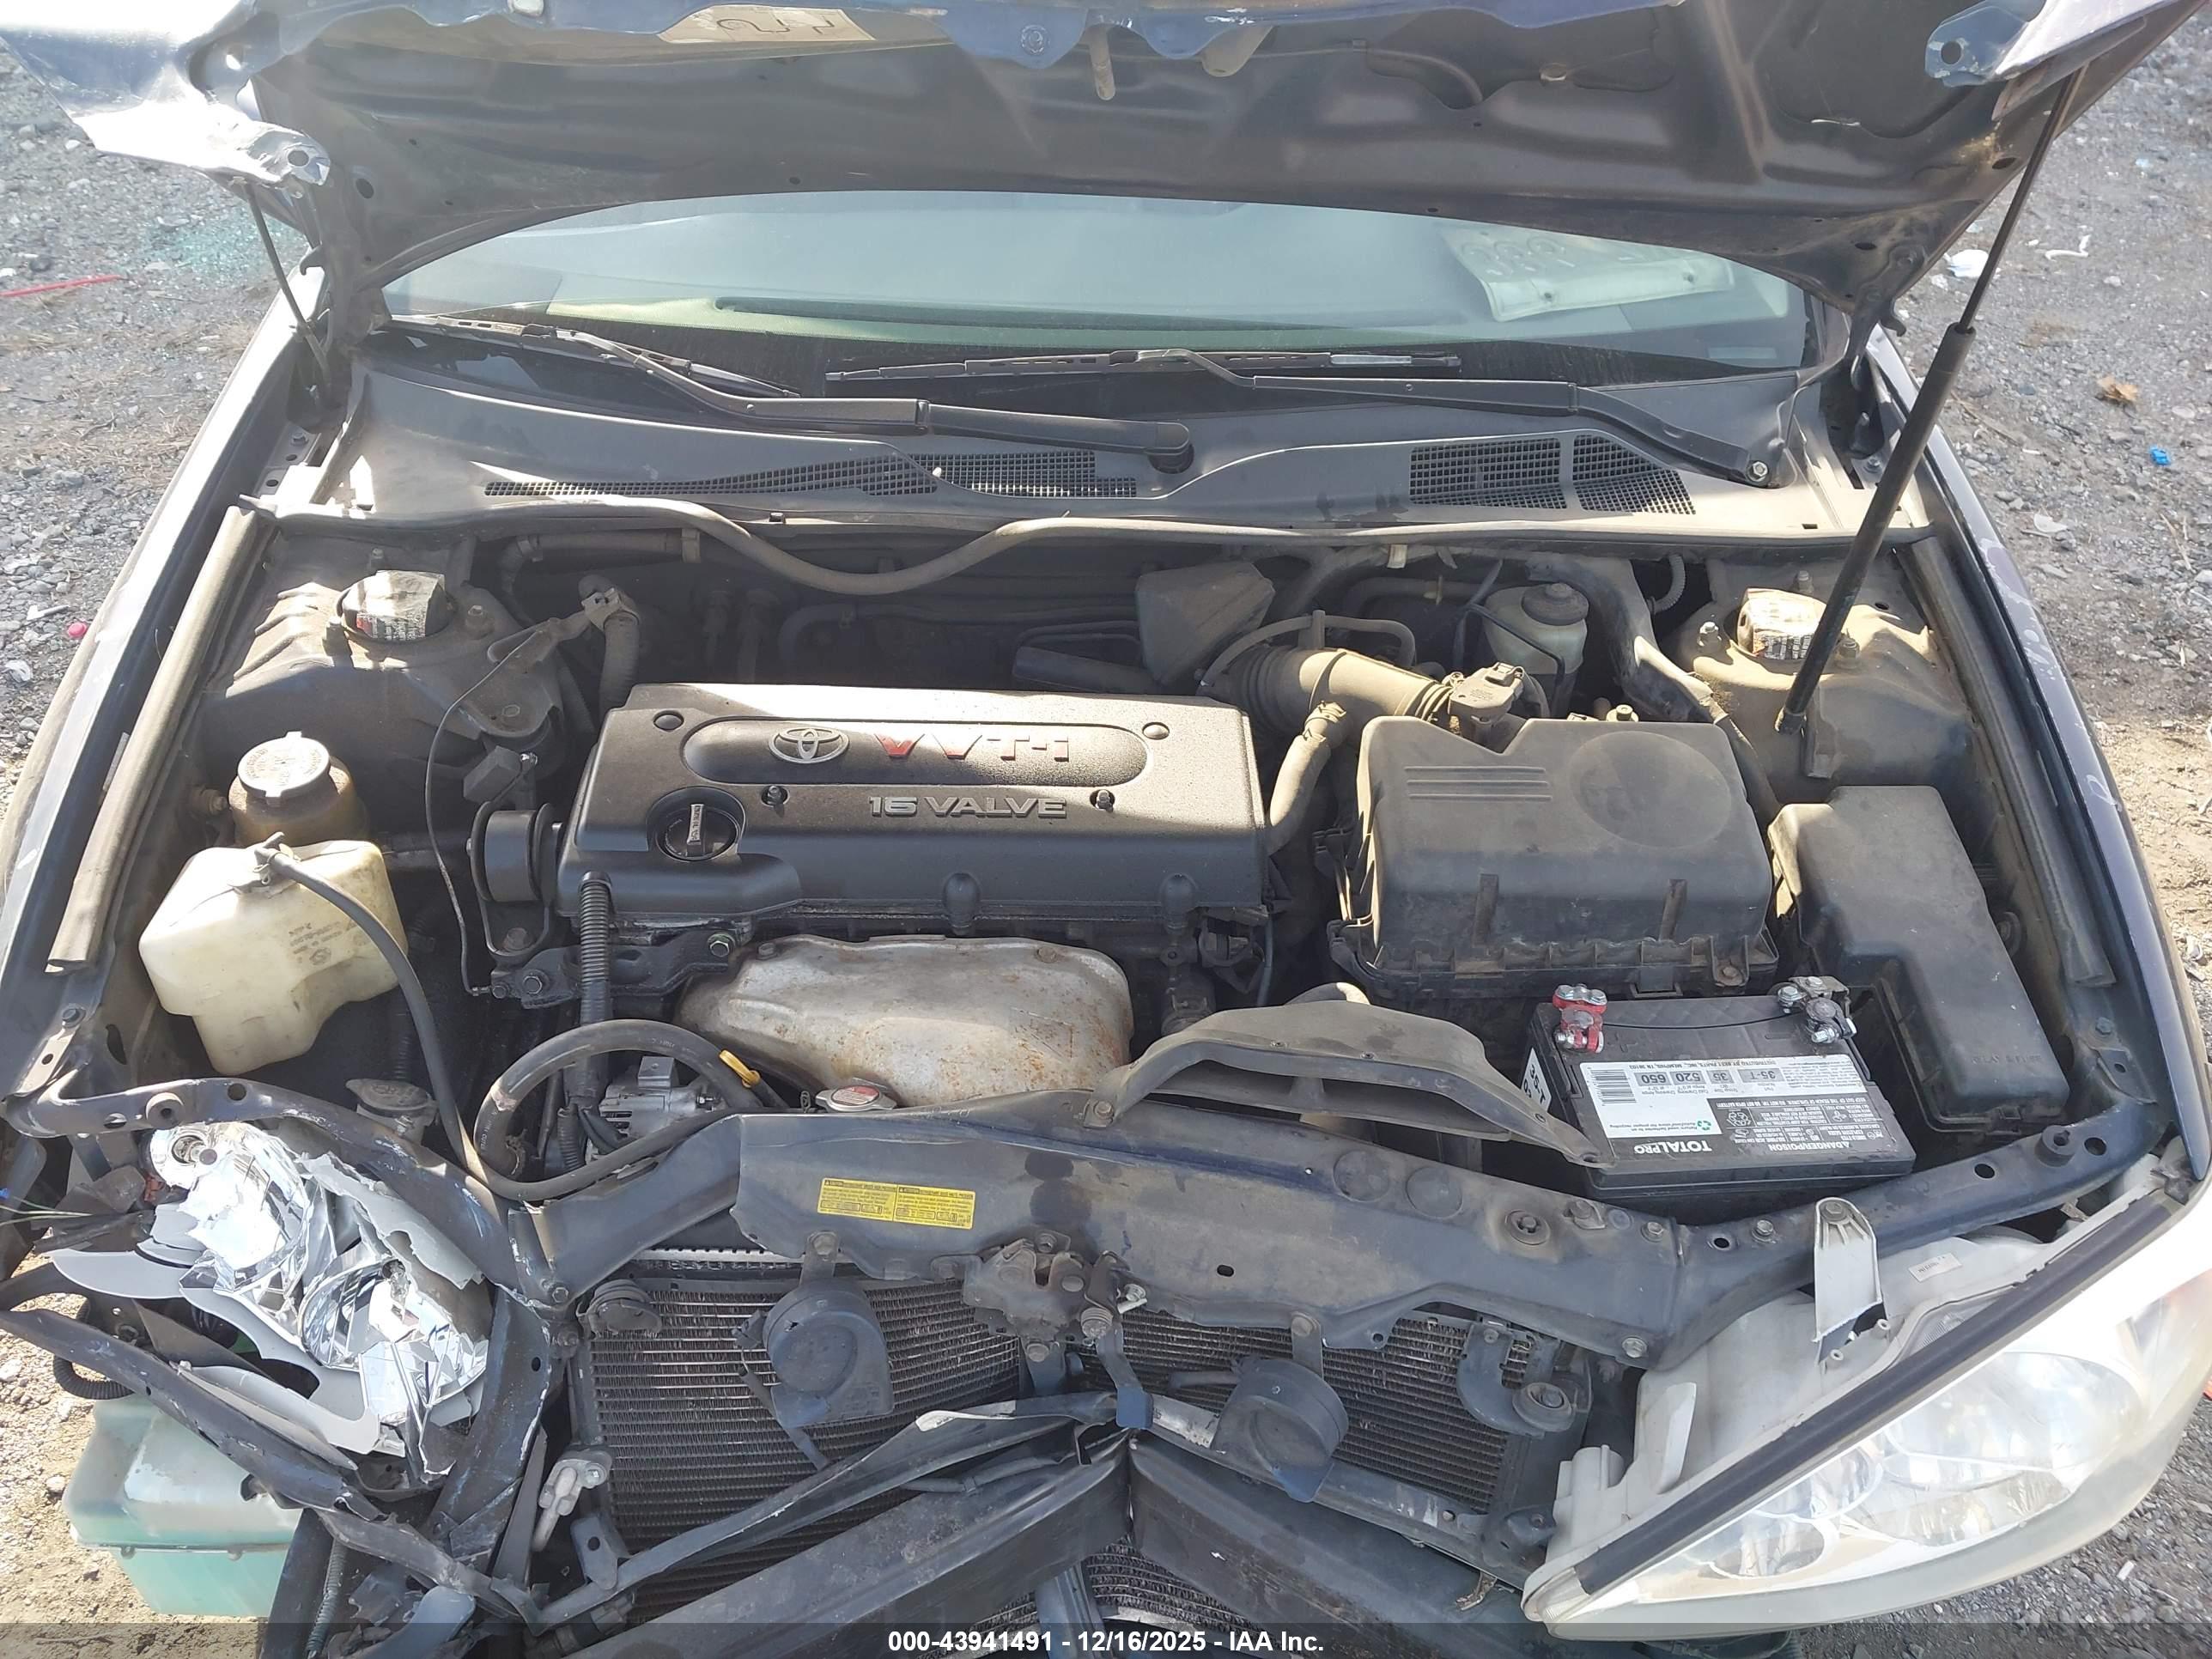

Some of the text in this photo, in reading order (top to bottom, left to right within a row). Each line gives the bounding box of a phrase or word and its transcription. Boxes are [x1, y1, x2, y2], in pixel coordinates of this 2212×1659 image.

[869, 797, 1067, 818] 16 VALVE
[1640, 1074, 1666, 1084] 650
[1674, 1072, 1700, 1082] 520
[1713, 1072, 1727, 1081] 35
[1750, 1070, 1776, 1079] 35-T
[1768, 1141, 1844, 1151] DANGER/POISON
